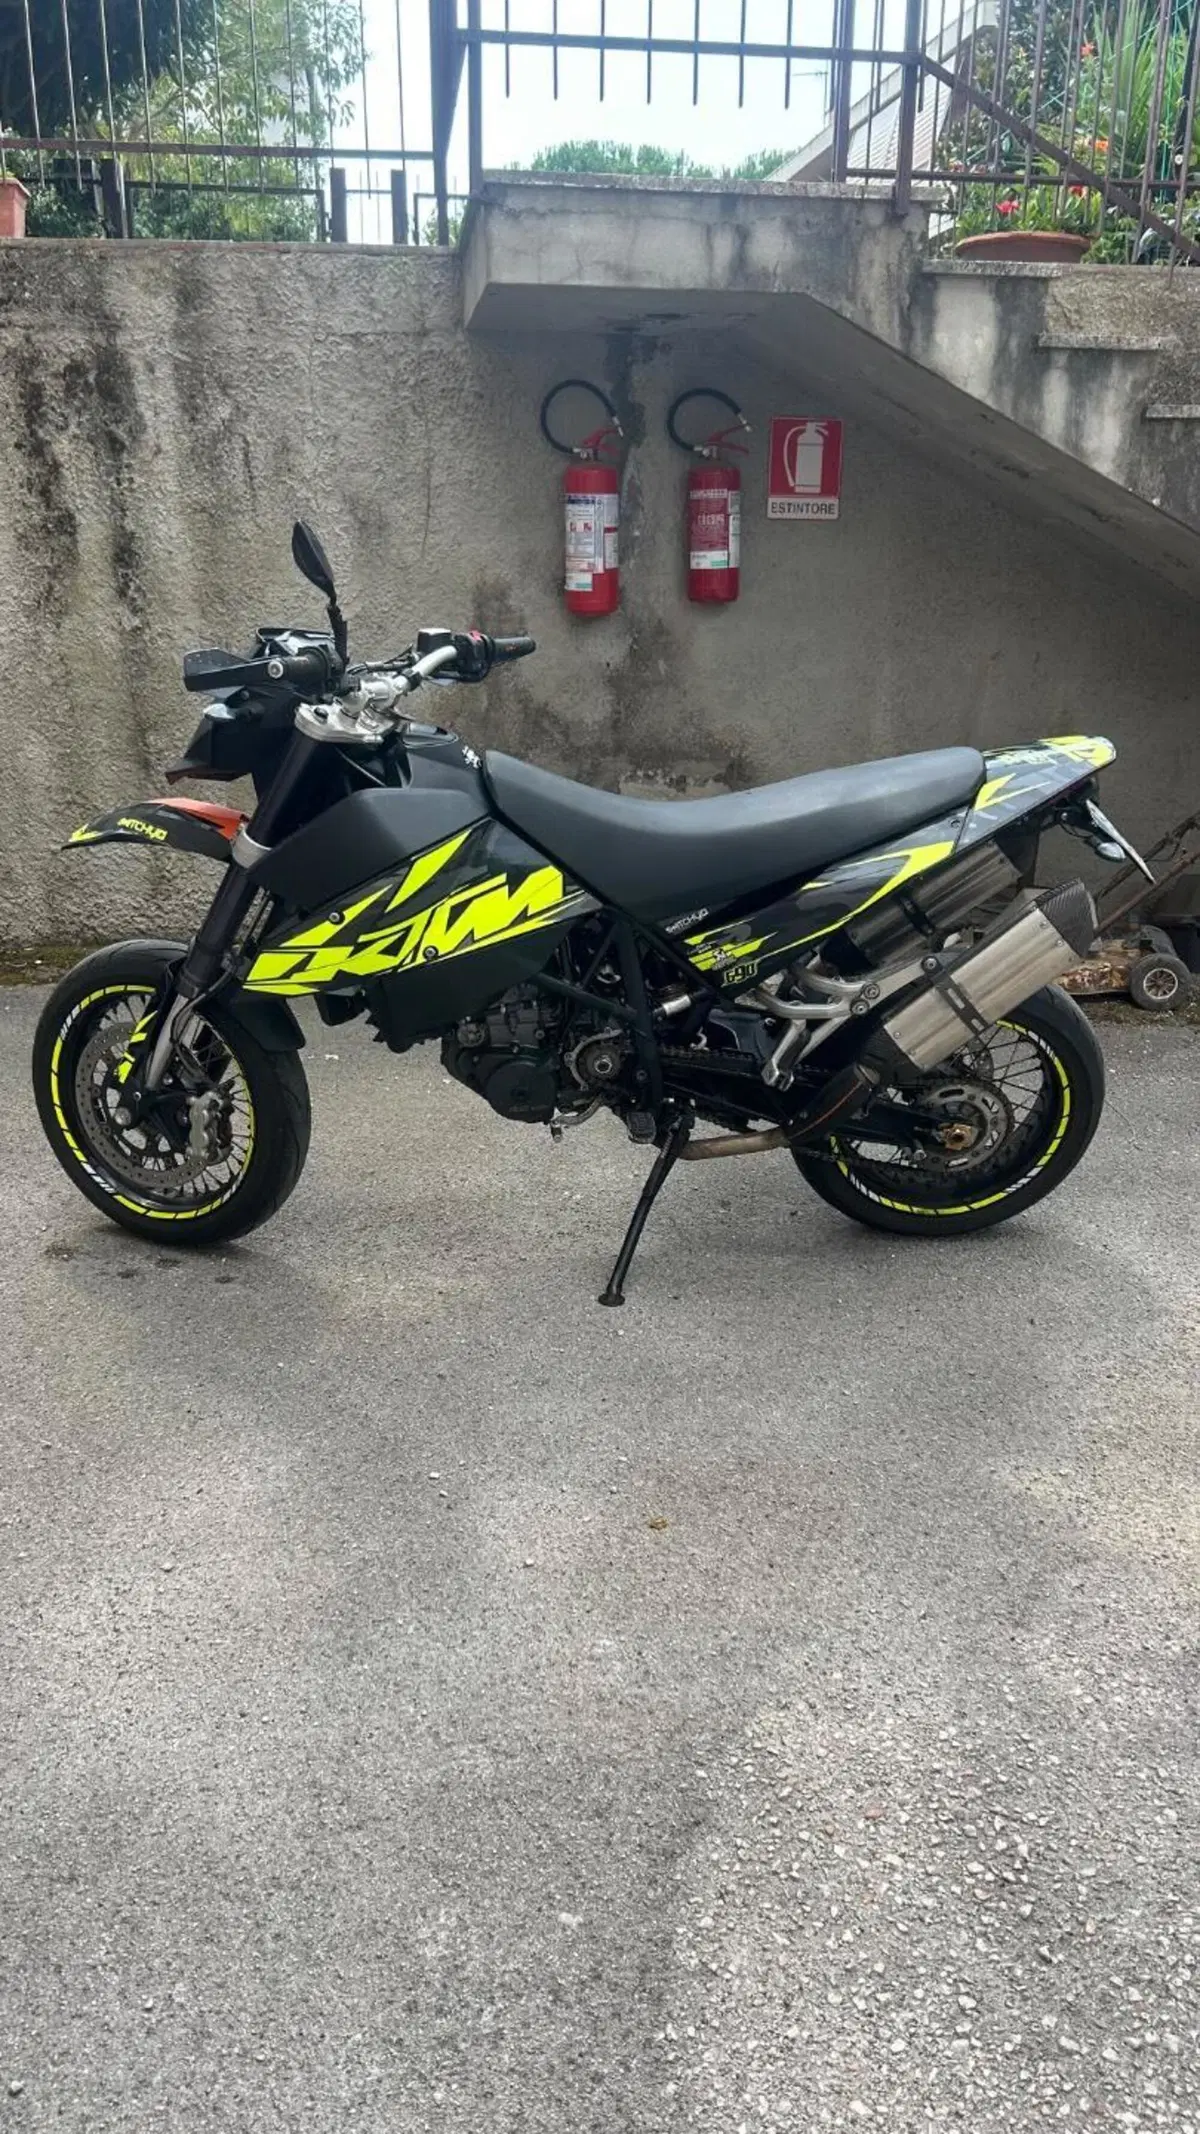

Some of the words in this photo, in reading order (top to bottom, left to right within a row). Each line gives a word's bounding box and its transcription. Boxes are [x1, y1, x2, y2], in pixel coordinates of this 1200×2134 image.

[771, 501, 836, 515] ESTINTORE
[245, 864, 564, 984] KTM
[725, 961, 757, 984] 690
